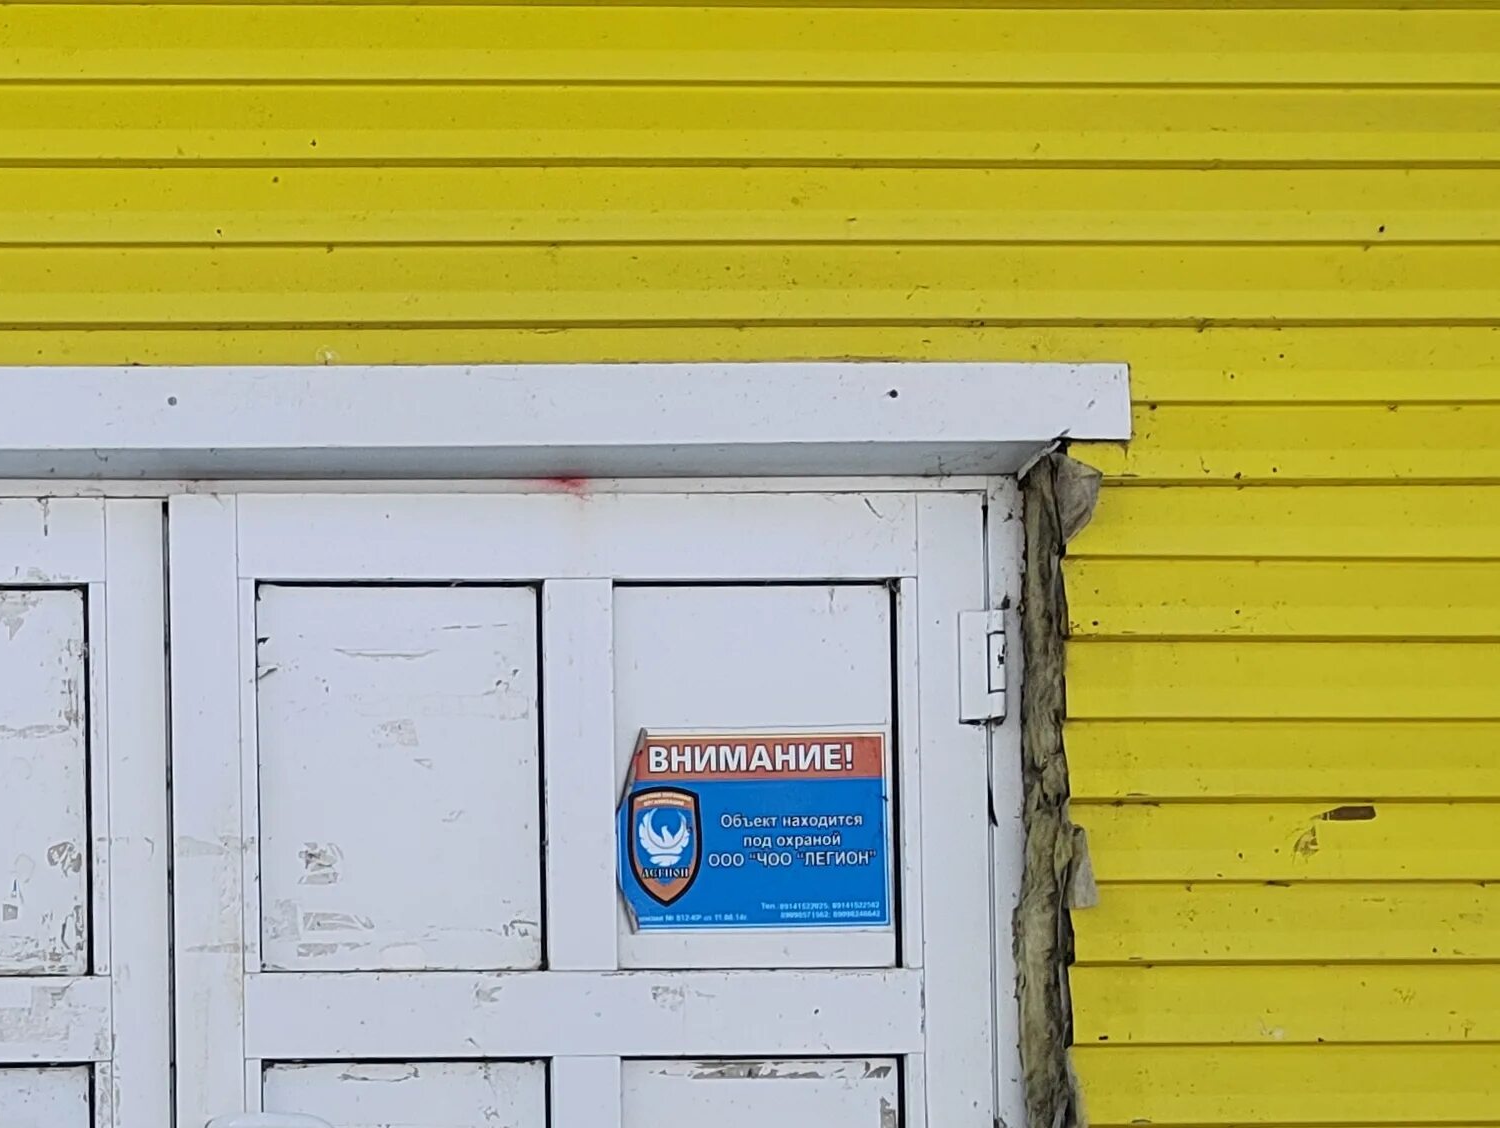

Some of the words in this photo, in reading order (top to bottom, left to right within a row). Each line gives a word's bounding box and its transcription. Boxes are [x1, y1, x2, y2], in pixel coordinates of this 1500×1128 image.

[649, 744, 854, 772] ВНИМАНИЕ!
[720, 814, 777, 829] Объект
[782, 815, 863, 829] находится
[743, 836, 772, 848] под
[776, 833, 841, 849] охраной
[708, 853, 745, 867] ООО
